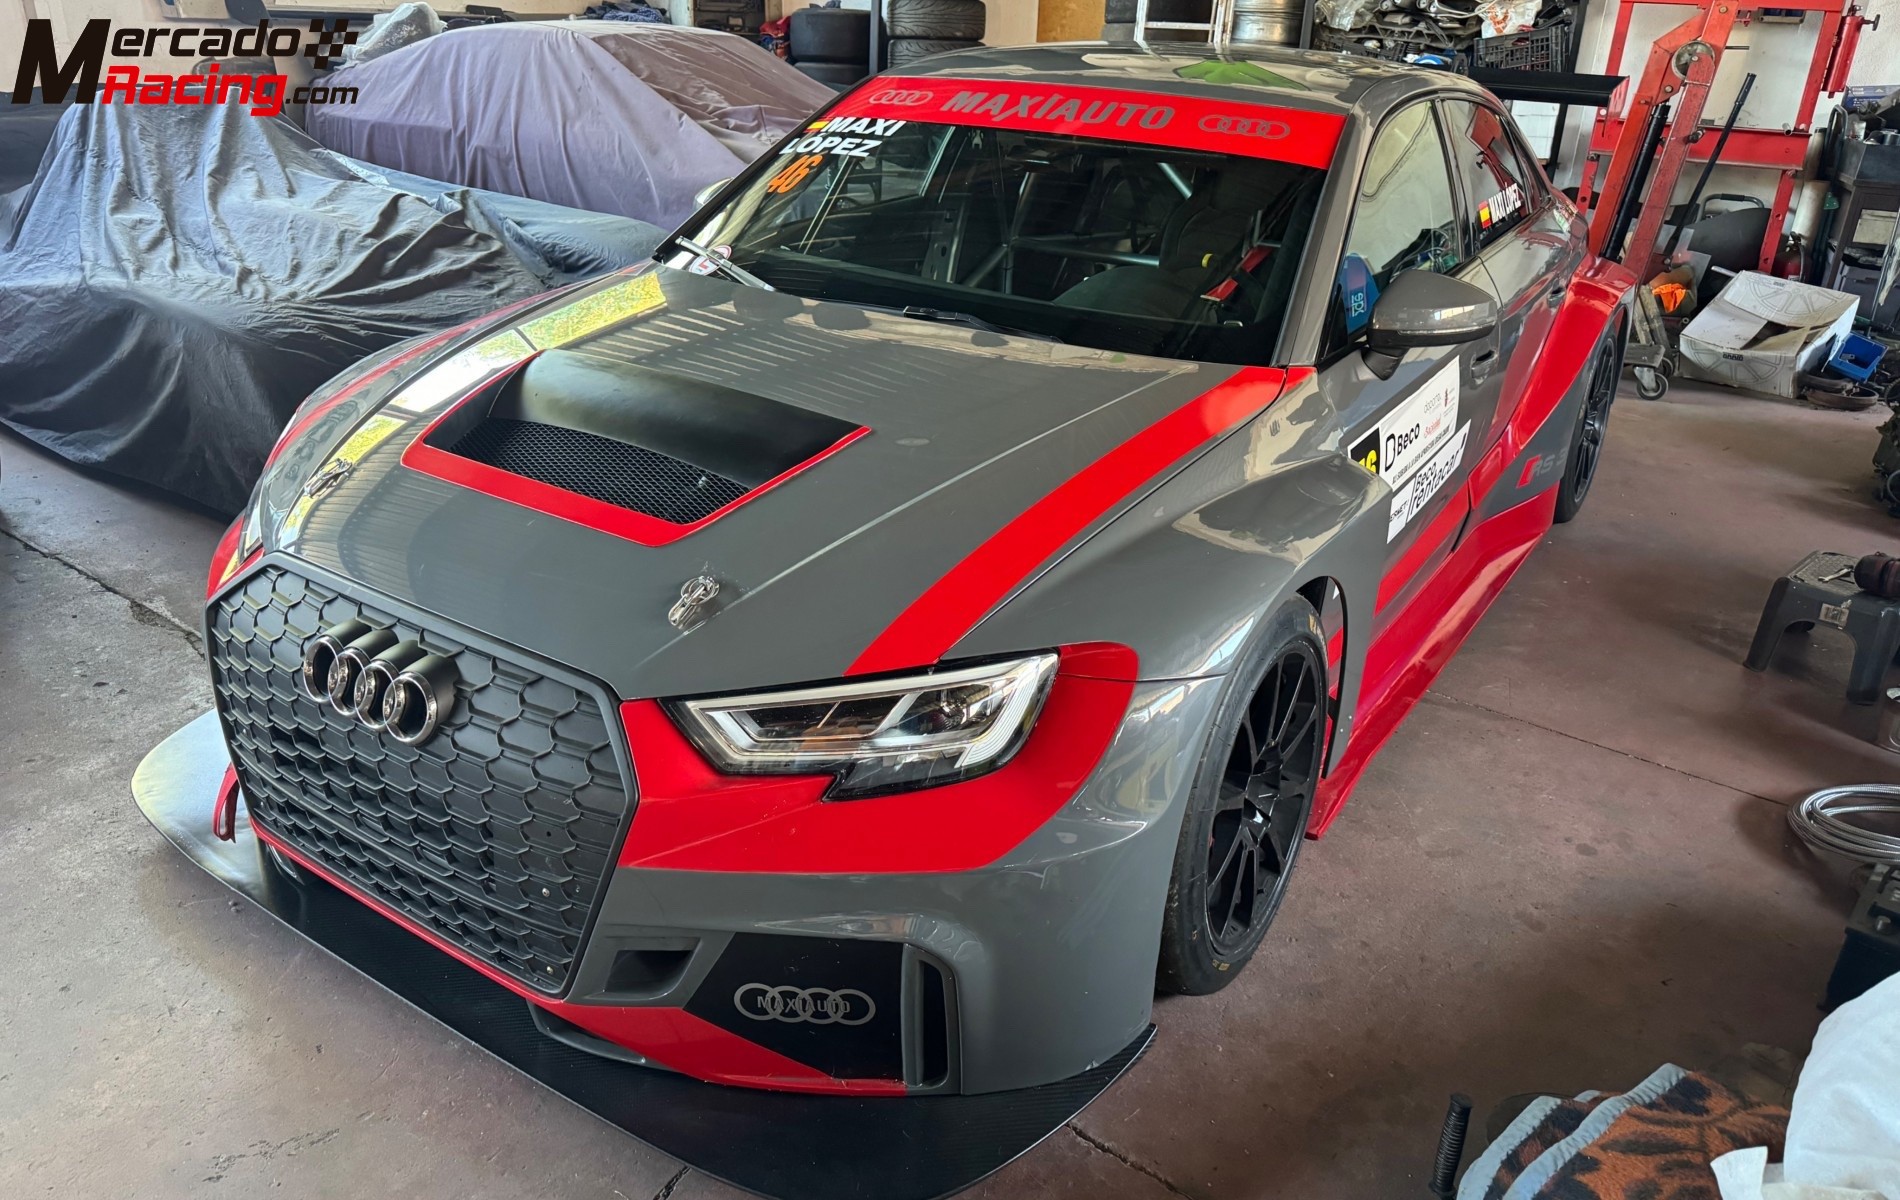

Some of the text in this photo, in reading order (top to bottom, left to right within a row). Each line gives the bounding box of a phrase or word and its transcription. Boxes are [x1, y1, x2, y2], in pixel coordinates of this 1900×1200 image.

[822, 117, 906, 137] MAXI
[779, 133, 882, 158] LÓPEZ
[766, 154, 822, 195] 46
[1397, 422, 1421, 457] Beco
[1409, 449, 1460, 516] rentacar
[1415, 461, 1438, 494] Beco
[757, 996, 850, 1013] MAXIAUTO
